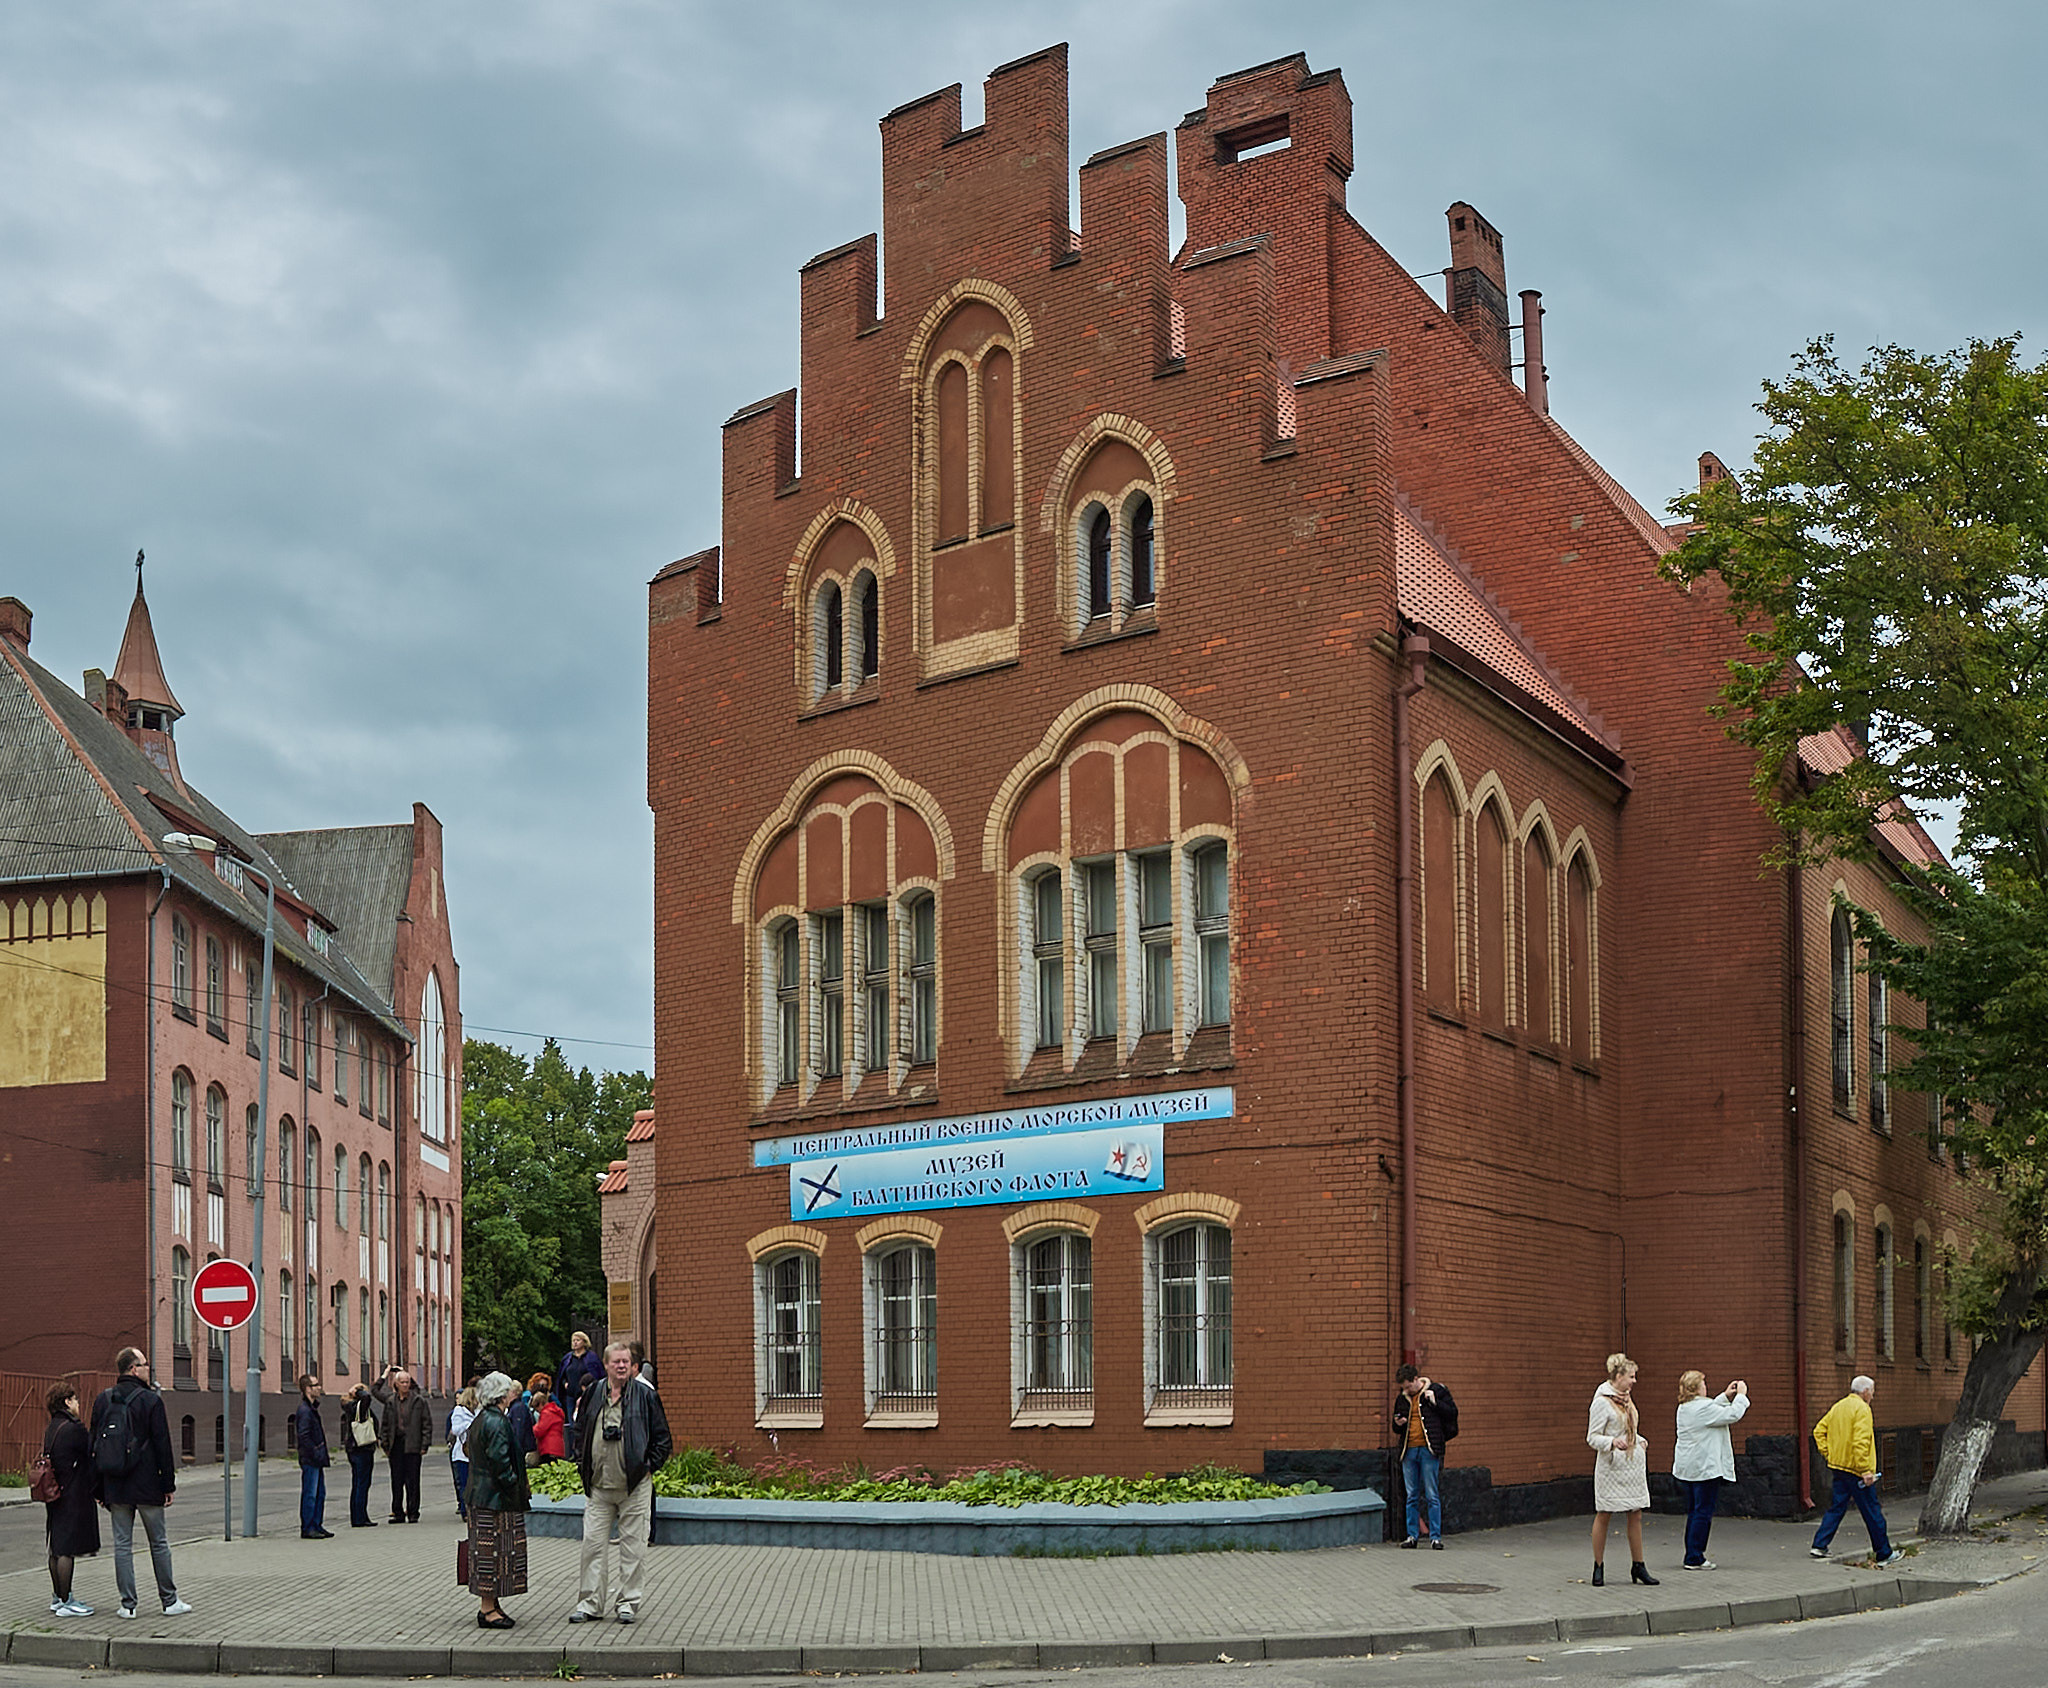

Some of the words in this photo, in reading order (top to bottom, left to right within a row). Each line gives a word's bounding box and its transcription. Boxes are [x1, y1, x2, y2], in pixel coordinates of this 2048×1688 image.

[792, 1123, 931, 1156] ЦЕНТРАЛЬНЫЙ
[938, 1103, 1121, 1139] ВОЕННО-МОРСКОЙ
[1128, 1093, 1208, 1119] МУЗЕЙ
[925, 1150, 1005, 1177] МУЗЕЙ
[852, 1177, 1003, 1206] БАЛТИЙСКОГО
[1009, 1169, 1089, 1192] ФЛОТА
